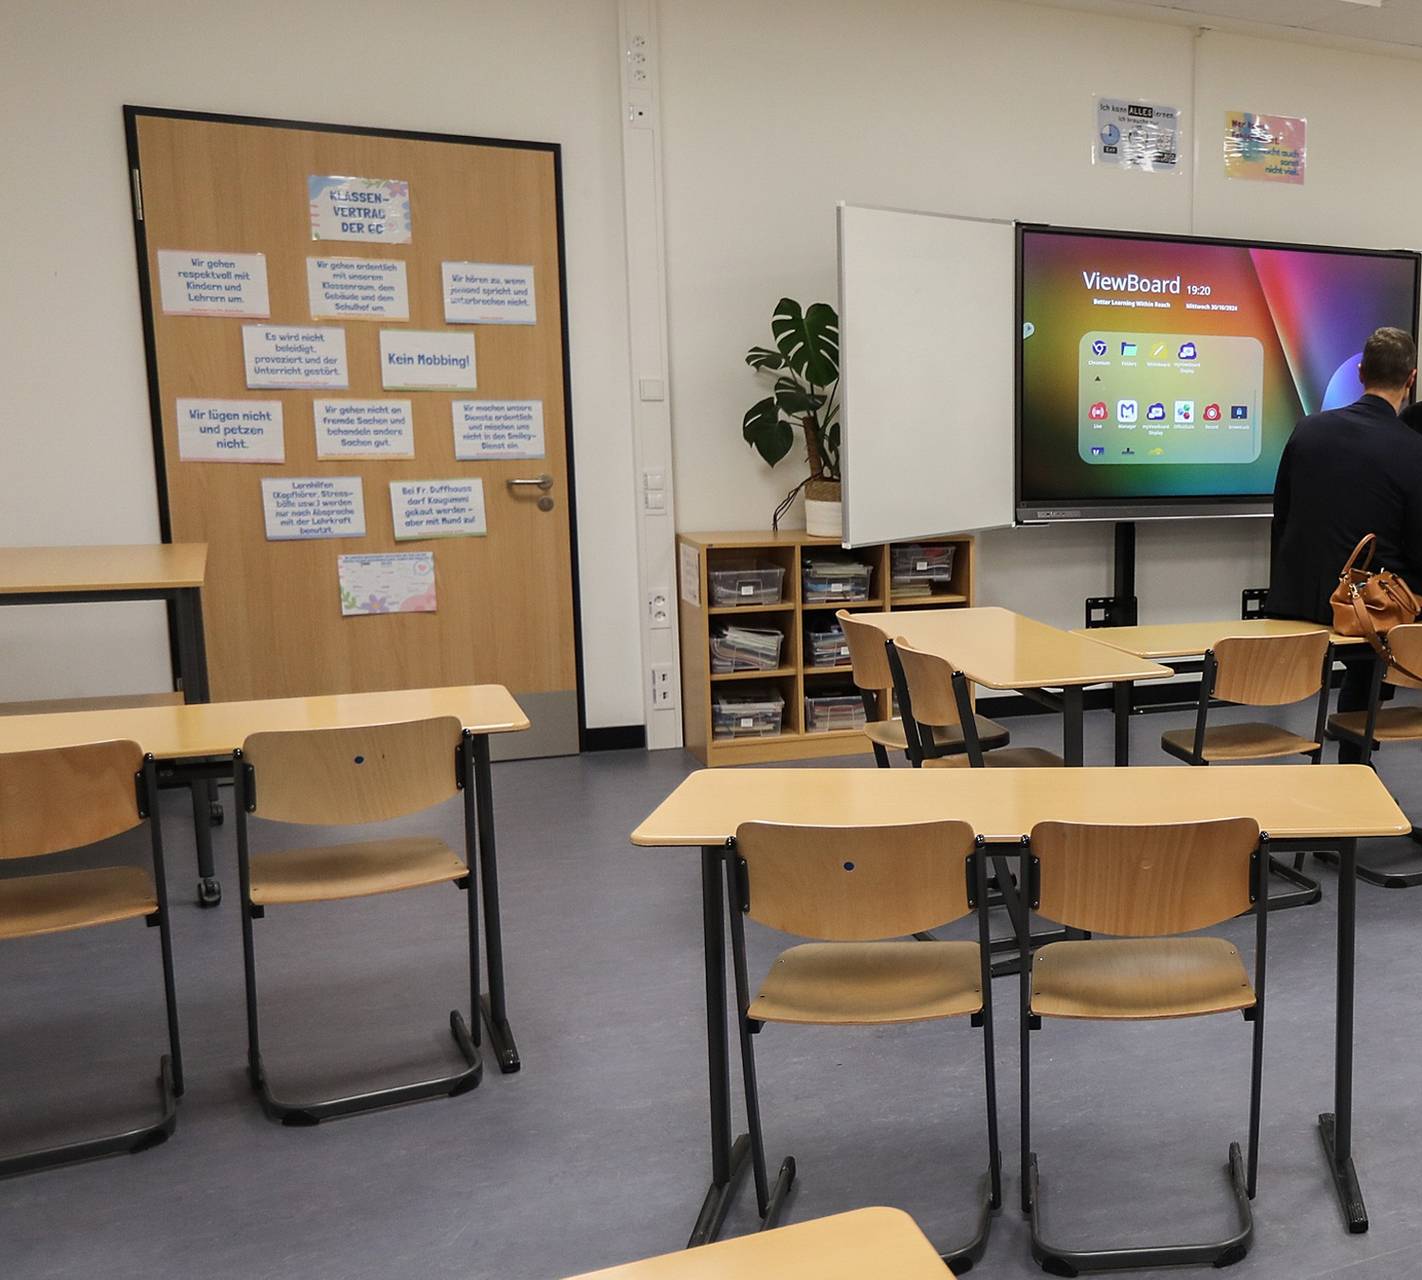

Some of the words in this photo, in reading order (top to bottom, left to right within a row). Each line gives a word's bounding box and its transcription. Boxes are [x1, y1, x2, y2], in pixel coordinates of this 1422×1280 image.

[1129, 106, 1152, 116] ALLES
[341, 222, 364, 234] DER
[191, 258, 205, 267] Wir
[207, 260, 235, 270] gehen
[178, 271, 233, 281] respektvoll
[234, 273, 251, 281] mit
[187, 281, 223, 290] Kindern
[224, 283, 242, 292] und
[1083, 272, 1181, 294] ViewBoard
[1187, 285, 1211, 296] 19:20
[188, 293, 226, 302] Lehrern
[1093, 298, 1111, 306] Better
[1112, 299, 1135, 308] Learning
[265, 332, 277, 341] Es
[279, 333, 300, 341] wird
[301, 333, 325, 342] nicht
[254, 355, 303, 364] provoziert
[305, 356, 321, 364] und
[323, 356, 338, 364] der
[388, 353, 414, 365] Kein
[417, 354, 470, 369] Mobbing!
[254, 366, 302, 375] Unterricht
[189, 409, 206, 419] Wir
[208, 409, 240, 422] lügen
[242, 411, 272, 421] nicht
[339, 406, 366, 415] gehen
[367, 406, 389, 414] nicht
[357, 416, 388, 424] Sachen
[390, 416, 406, 424] und
[199, 425, 221, 434] und
[223, 425, 264, 436] petzen
[216, 439, 250, 449] nicht.
[341, 438, 372, 446] Sachen
[404, 518, 424, 527] aber
